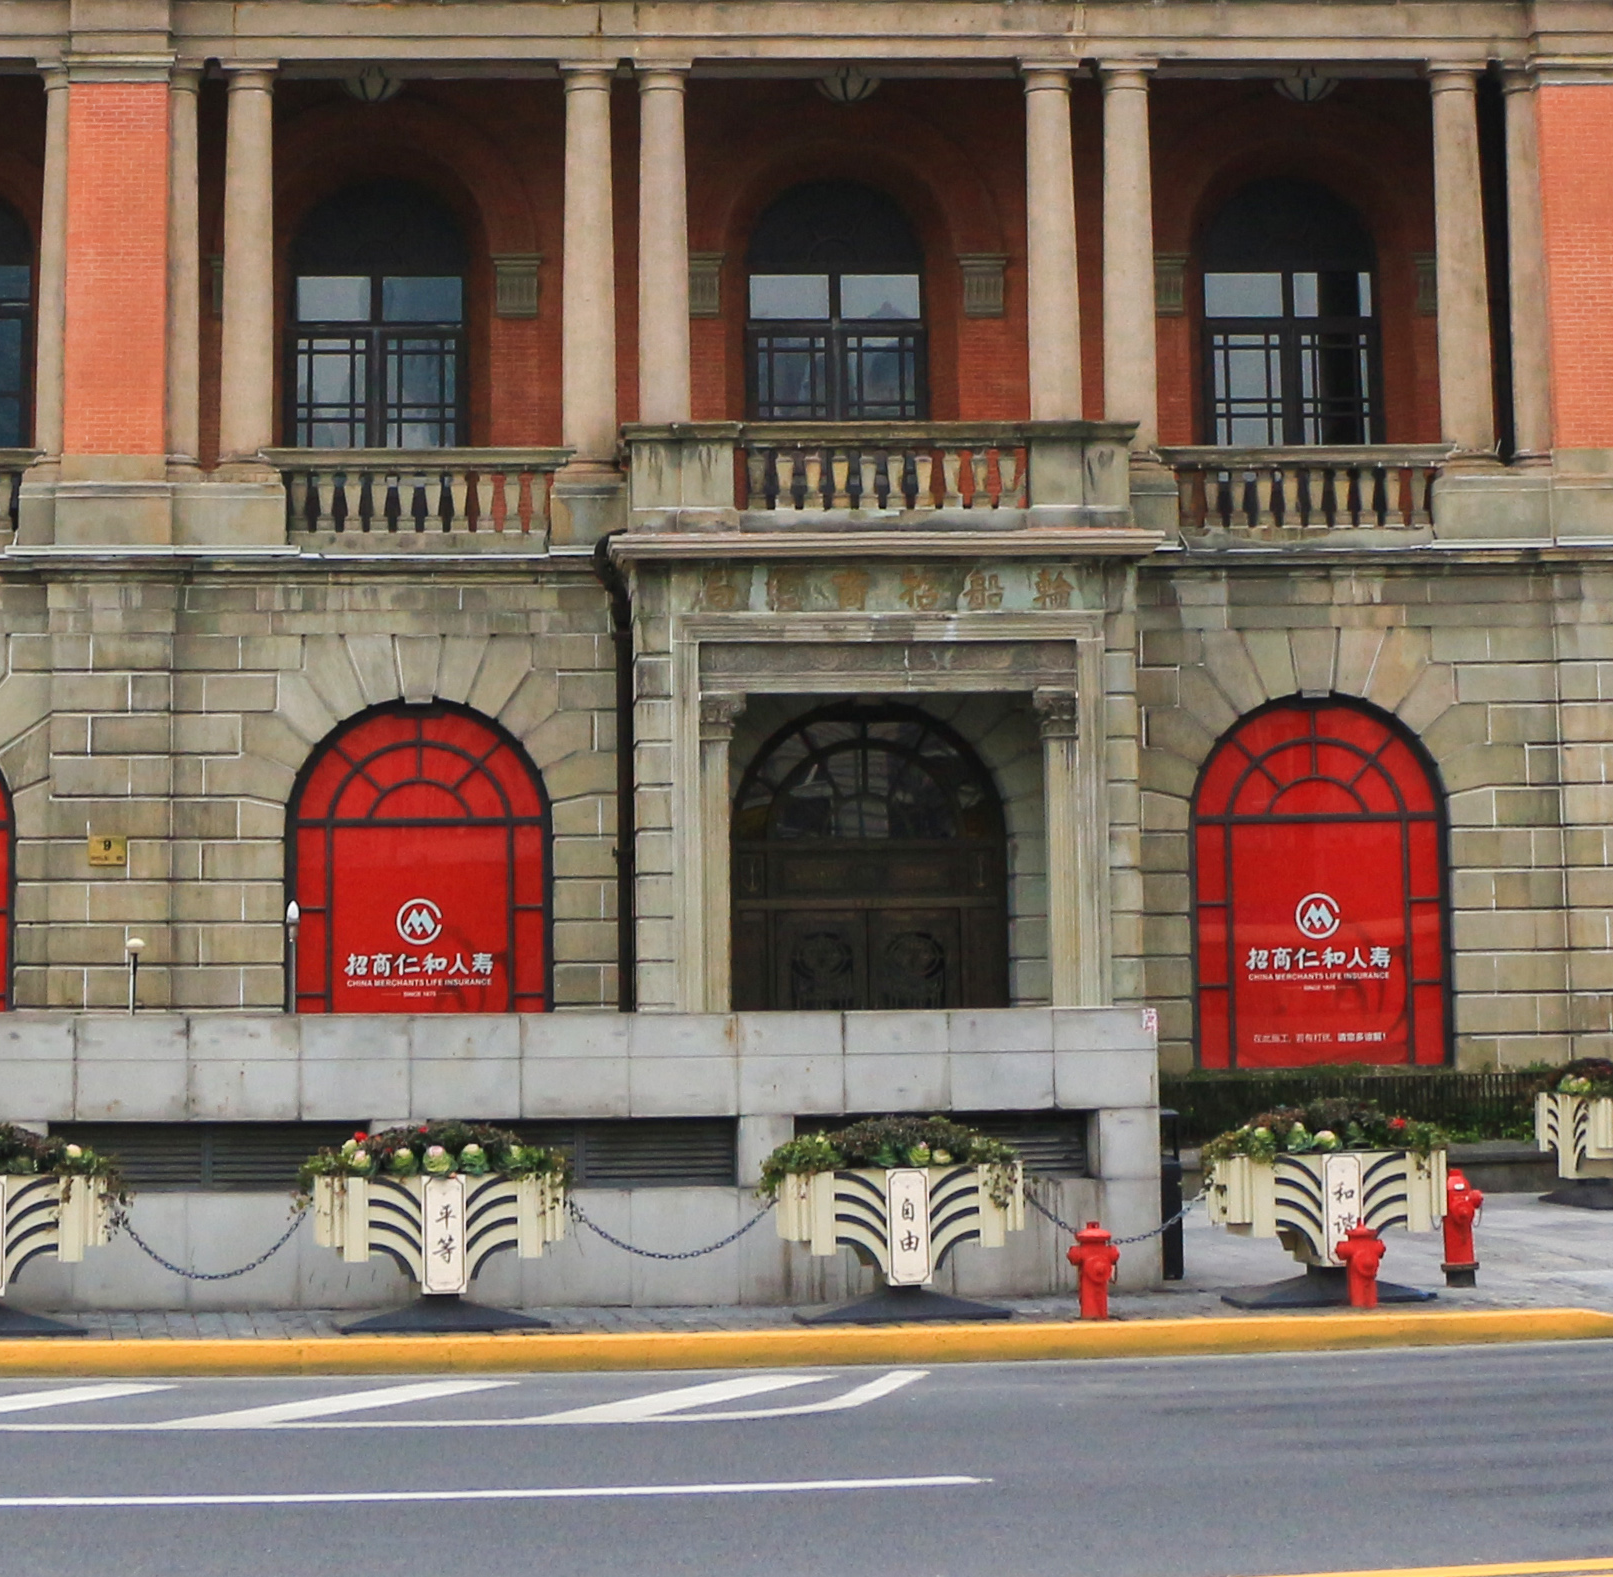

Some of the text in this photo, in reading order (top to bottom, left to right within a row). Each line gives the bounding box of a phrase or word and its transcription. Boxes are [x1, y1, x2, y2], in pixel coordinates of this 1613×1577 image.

[344, 952, 494, 976] 招商仁和人寿
[1245, 946, 1392, 971] 招商仁和人寿
[347, 978, 492, 988] CHINA MERCHANTS LIFE INSURANCE
[1248, 973, 1274, 981] CHINA
[1274, 973, 1324, 981] MERCHANTS
[1325, 972, 1342, 980] LIFE
[432, 1203, 457, 1264] 平等
[899, 1198, 920, 1253] 自由
